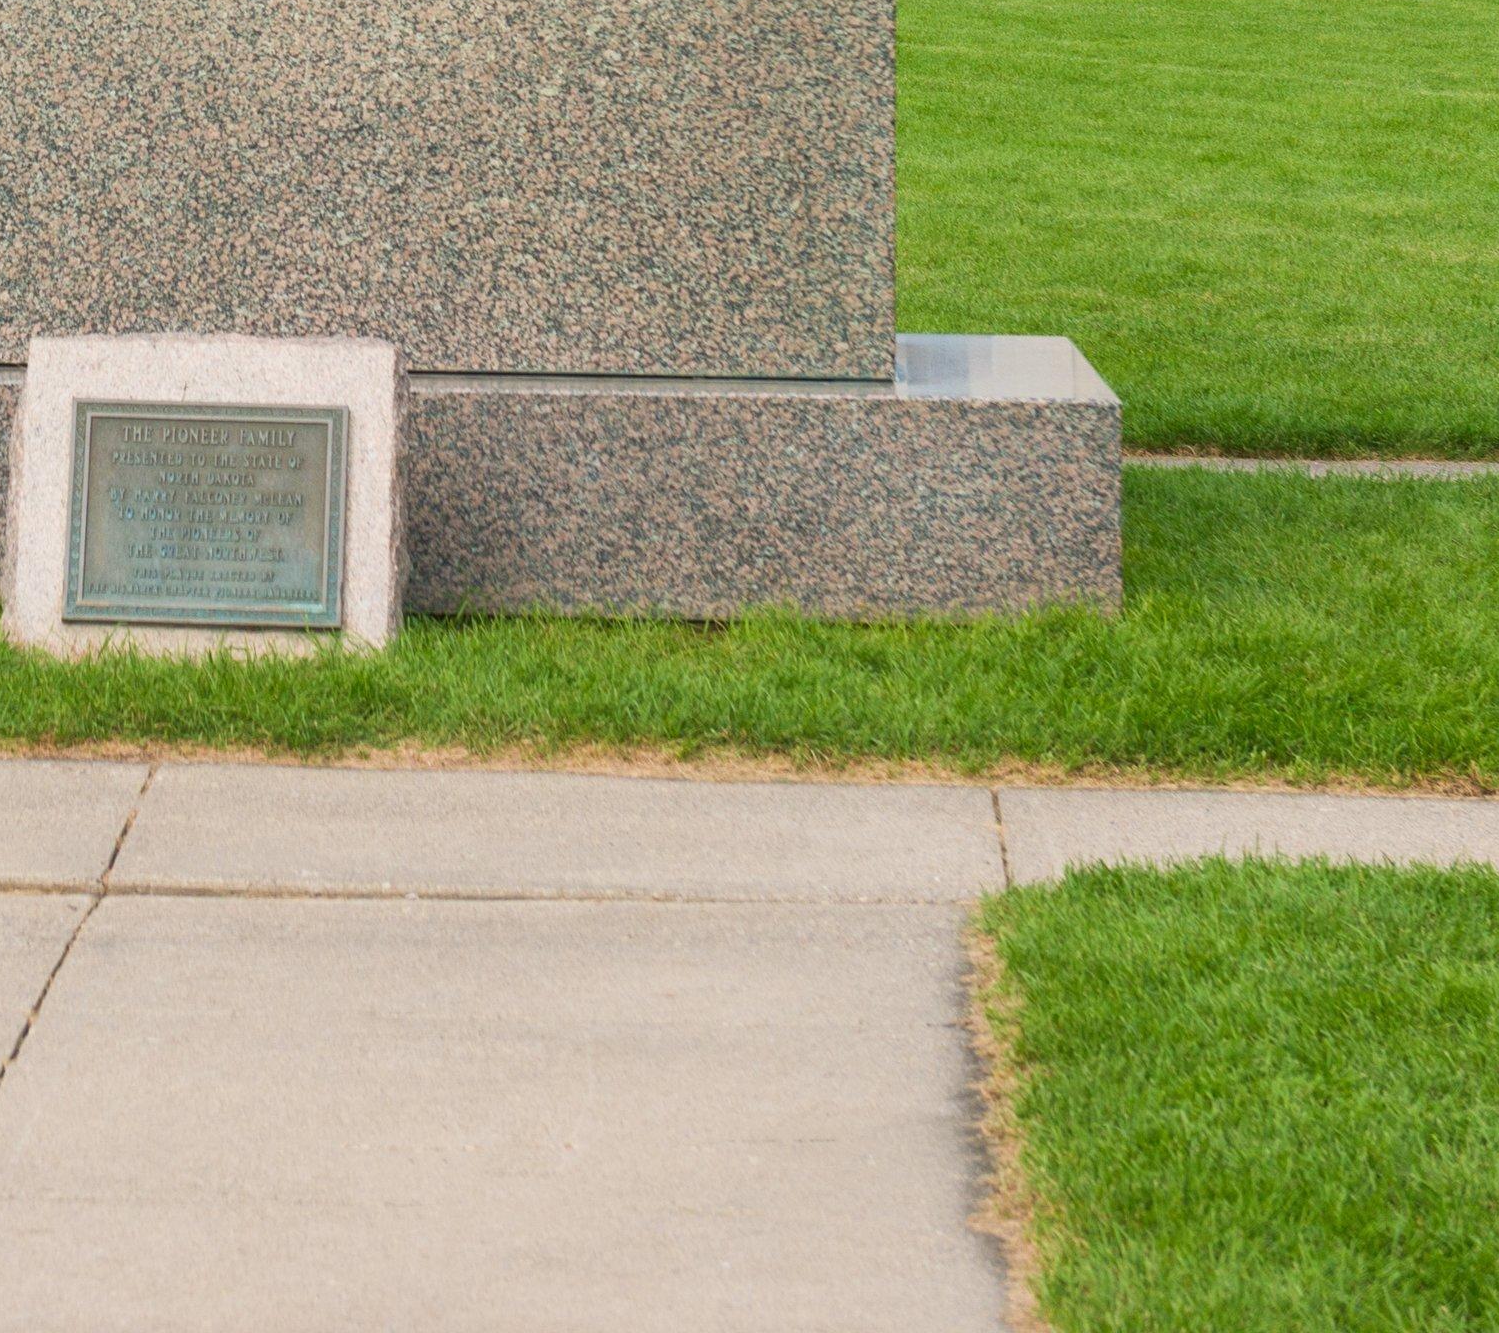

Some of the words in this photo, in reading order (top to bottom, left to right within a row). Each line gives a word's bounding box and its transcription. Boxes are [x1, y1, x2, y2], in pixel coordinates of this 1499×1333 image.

[123, 425, 153, 444] THE
[162, 426, 229, 446] PIONEER
[240, 428, 296, 448] FAMILY
[112, 451, 183, 466] PRESENTED
[191, 453, 205, 467] TO
[214, 453, 236, 468] THE
[244, 454, 282, 469] STATE
[288, 456, 304, 470] OF
[160, 471, 200, 485] NORTH
[207, 472, 254, 487] DAKOTA
[109, 487, 125, 501] BY
[135, 489, 177, 503] HARRY
[184, 490, 247, 505] FALCONER
[119, 505, 134, 520] TO
[141, 506, 180, 522] HONOR
[189, 508, 213, 523] THE
[219, 509, 269, 525] MEMORY
[277, 511, 294, 526] OF
[150, 526, 174, 540] THE
[182, 527, 241, 542] PIONEERS
[247, 529, 261, 543] OF
[128, 543, 152, 558] THE
[161, 544, 198, 560] GREAT
